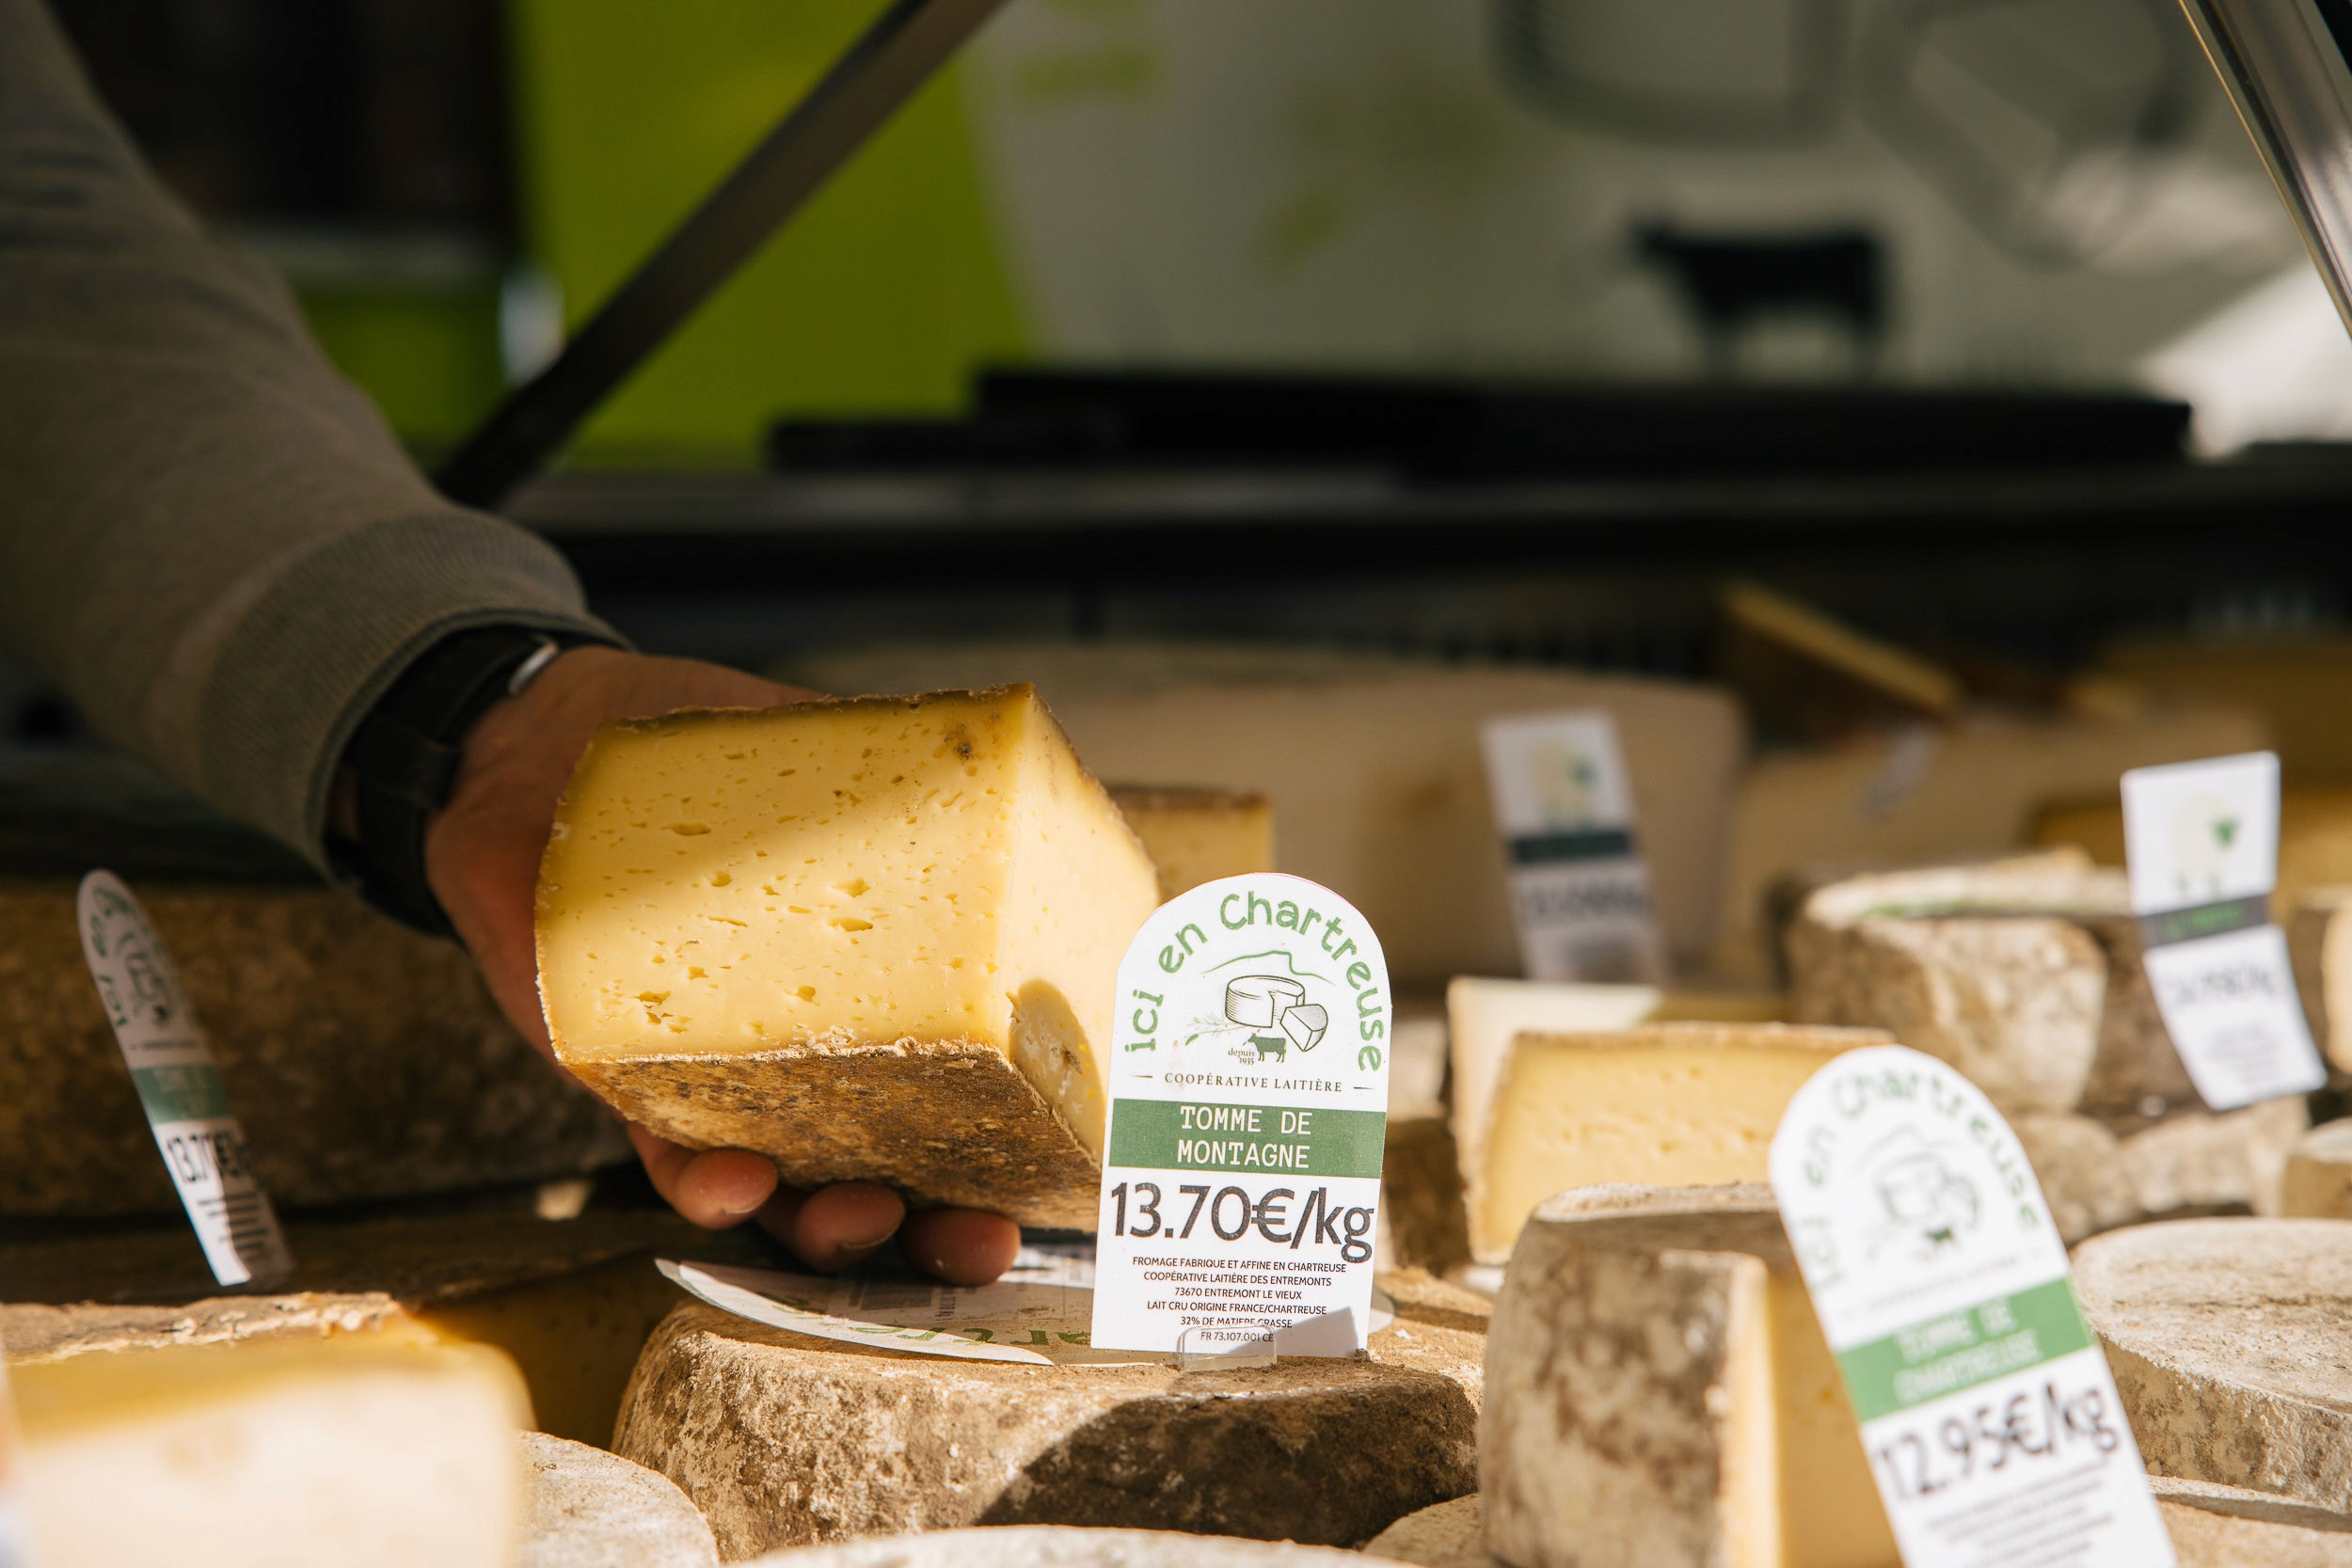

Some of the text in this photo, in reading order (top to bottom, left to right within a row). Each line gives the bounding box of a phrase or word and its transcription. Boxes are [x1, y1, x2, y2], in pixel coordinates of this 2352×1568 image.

[1124, 891, 1385, 1072] ici en Chartreuse
[1228, 1047, 1255, 1058] depuis
[1239, 1057, 1255, 1066] 1935
[1165, 1072, 1342, 1092] COOPÉRATIVE LAITIÈRE
[1180, 1105, 1312, 1135] TOMME DE
[1177, 1139, 1310, 1168] MONTAGNE
[1111, 1182, 1375, 1263] 13.70€/kg
[1133, 1257, 1346, 1273] FROMAGE FABRIQUE ET AFFINE EN CHARTREUSE
[1143, 1271, 1332, 1287] COOPÉRATIVE LAITIÈRE DES ENTREMONTS
[1175, 1287, 1302, 1300] 73670 ENTREMONT LE VIEUX
[1147, 1301, 1327, 1315] LAIT CRU ORIGINE FRANCE/CHARTREUSE
[1181, 1316, 1200, 1325] 32%
[1202, 1317, 1215, 1325] DE
[1200, 1331, 1212, 1340] FR
[1263, 1333, 1274, 1342] CE
